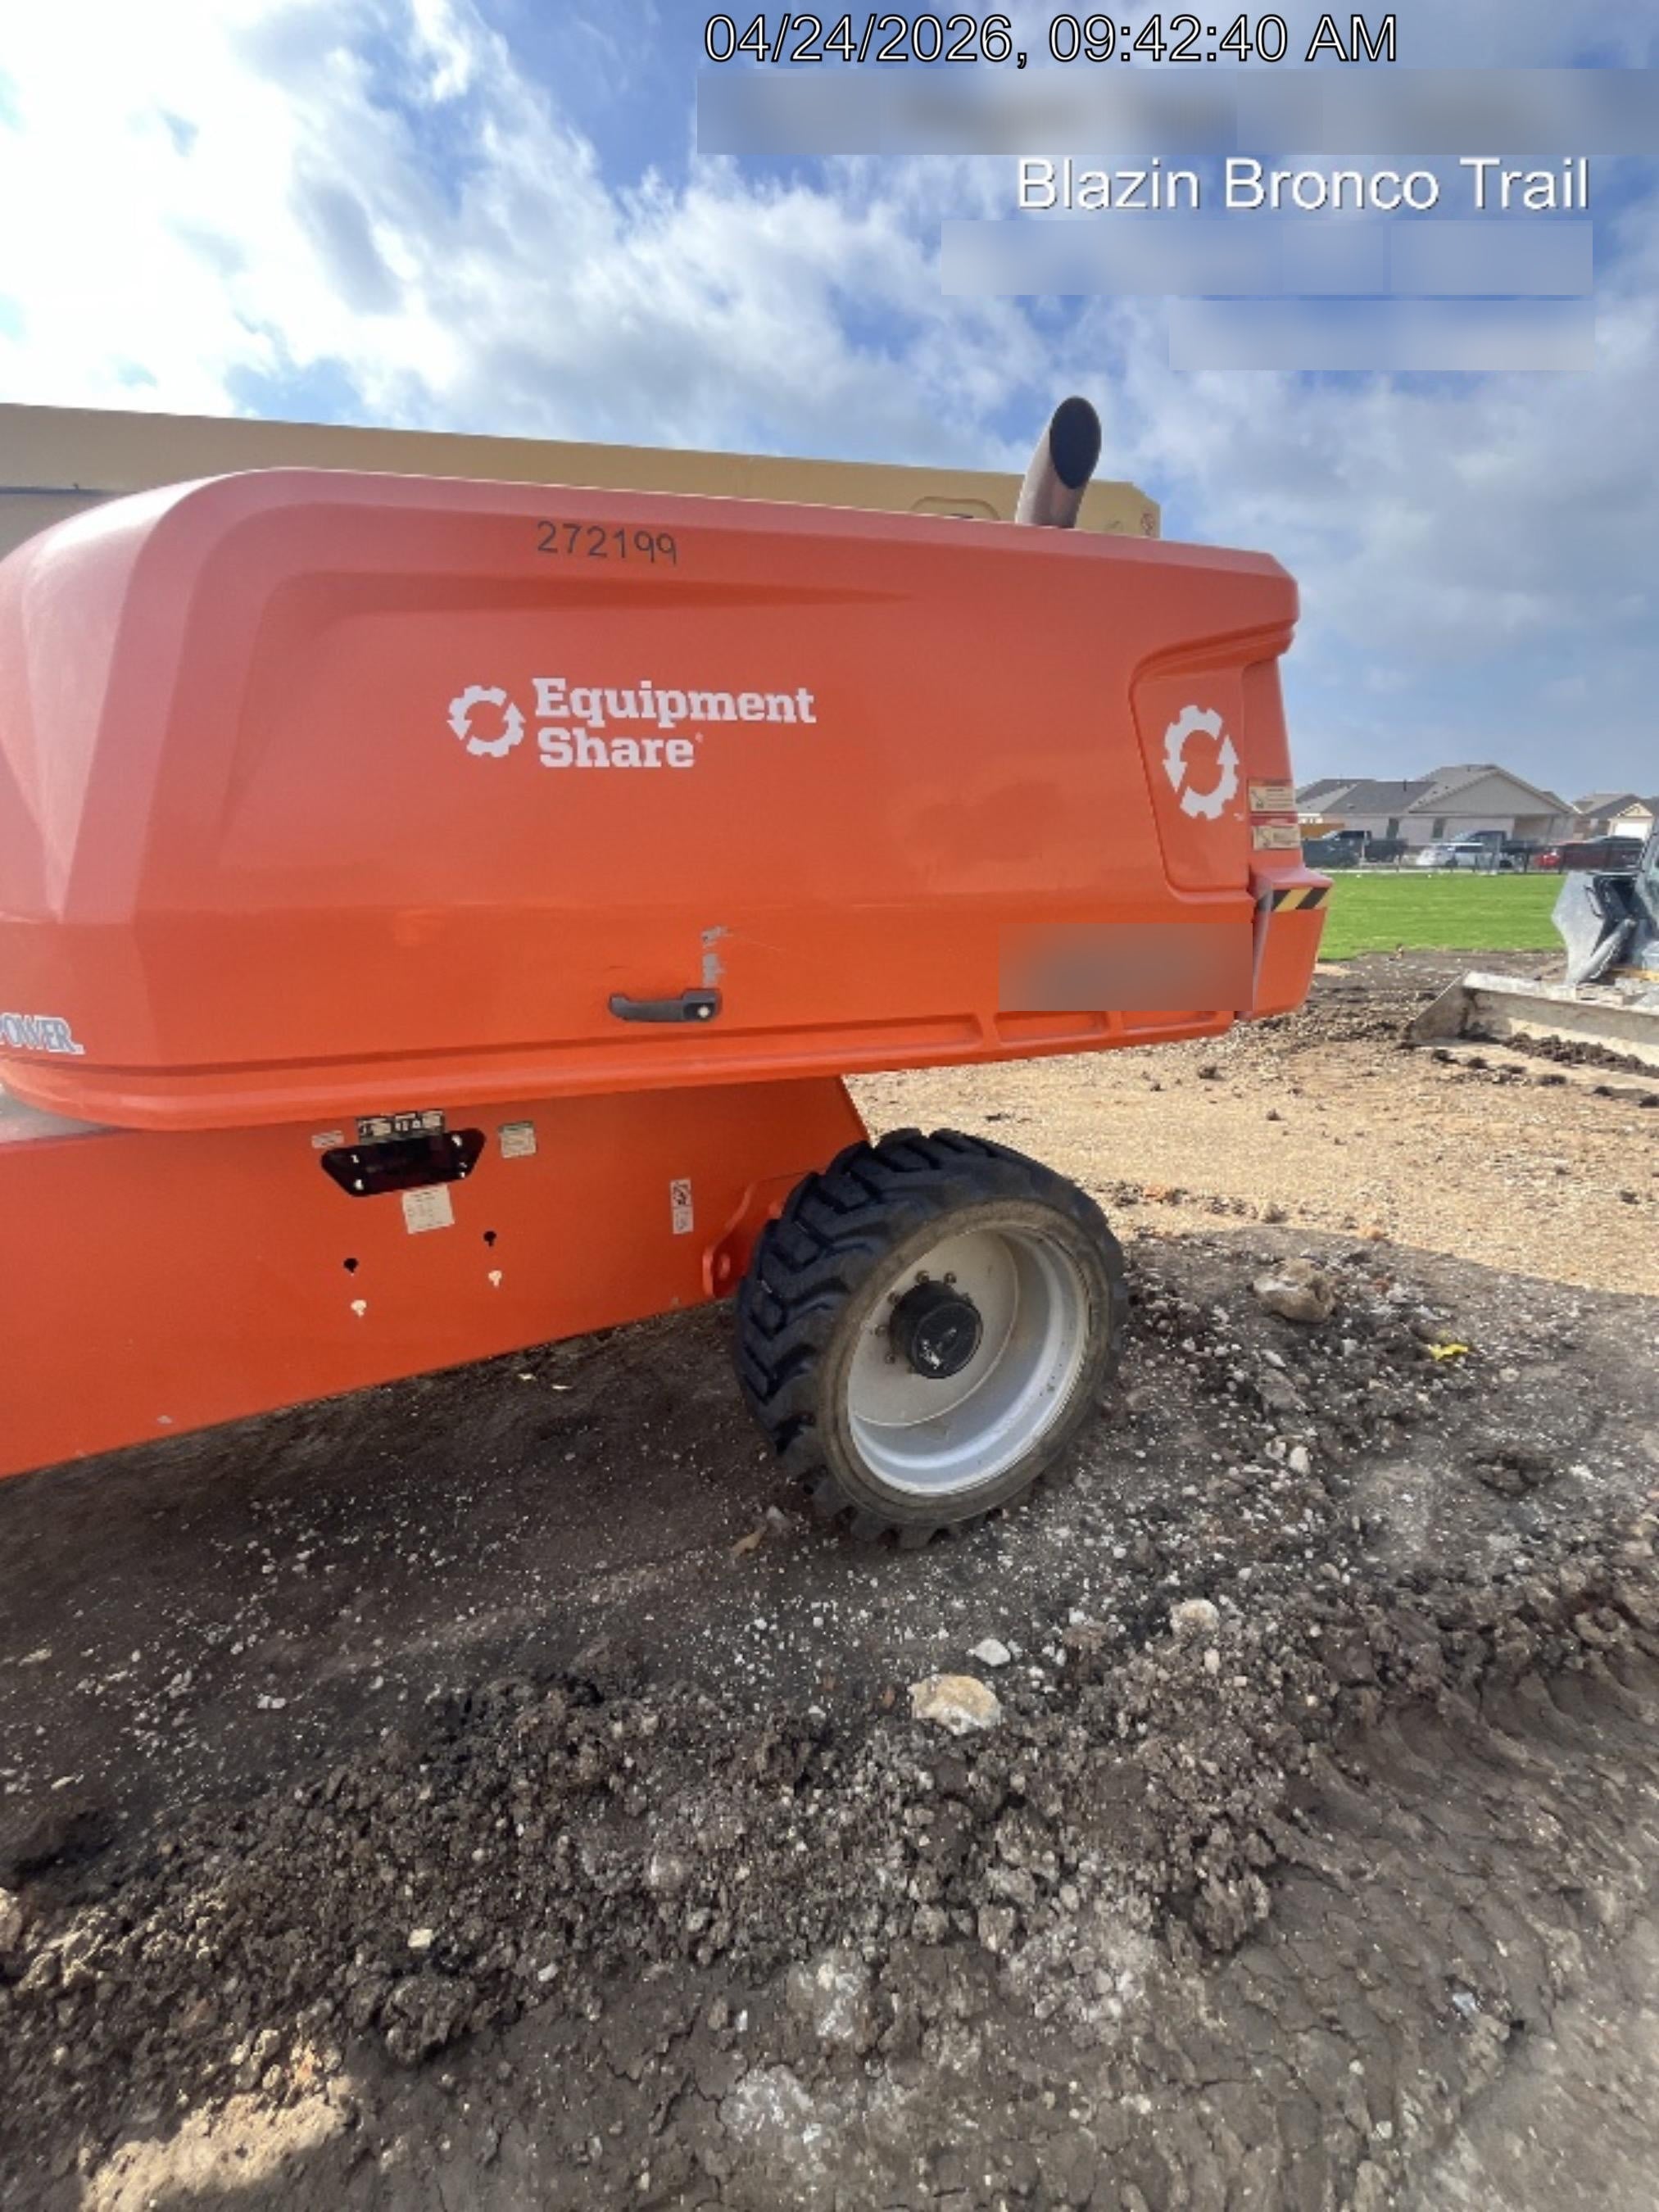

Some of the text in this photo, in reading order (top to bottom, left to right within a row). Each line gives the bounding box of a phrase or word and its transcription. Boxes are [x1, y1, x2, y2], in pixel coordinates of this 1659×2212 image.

[536, 519, 678, 565] 272199
[532, 677, 818, 729] Equipment
[537, 726, 696, 768] Share
